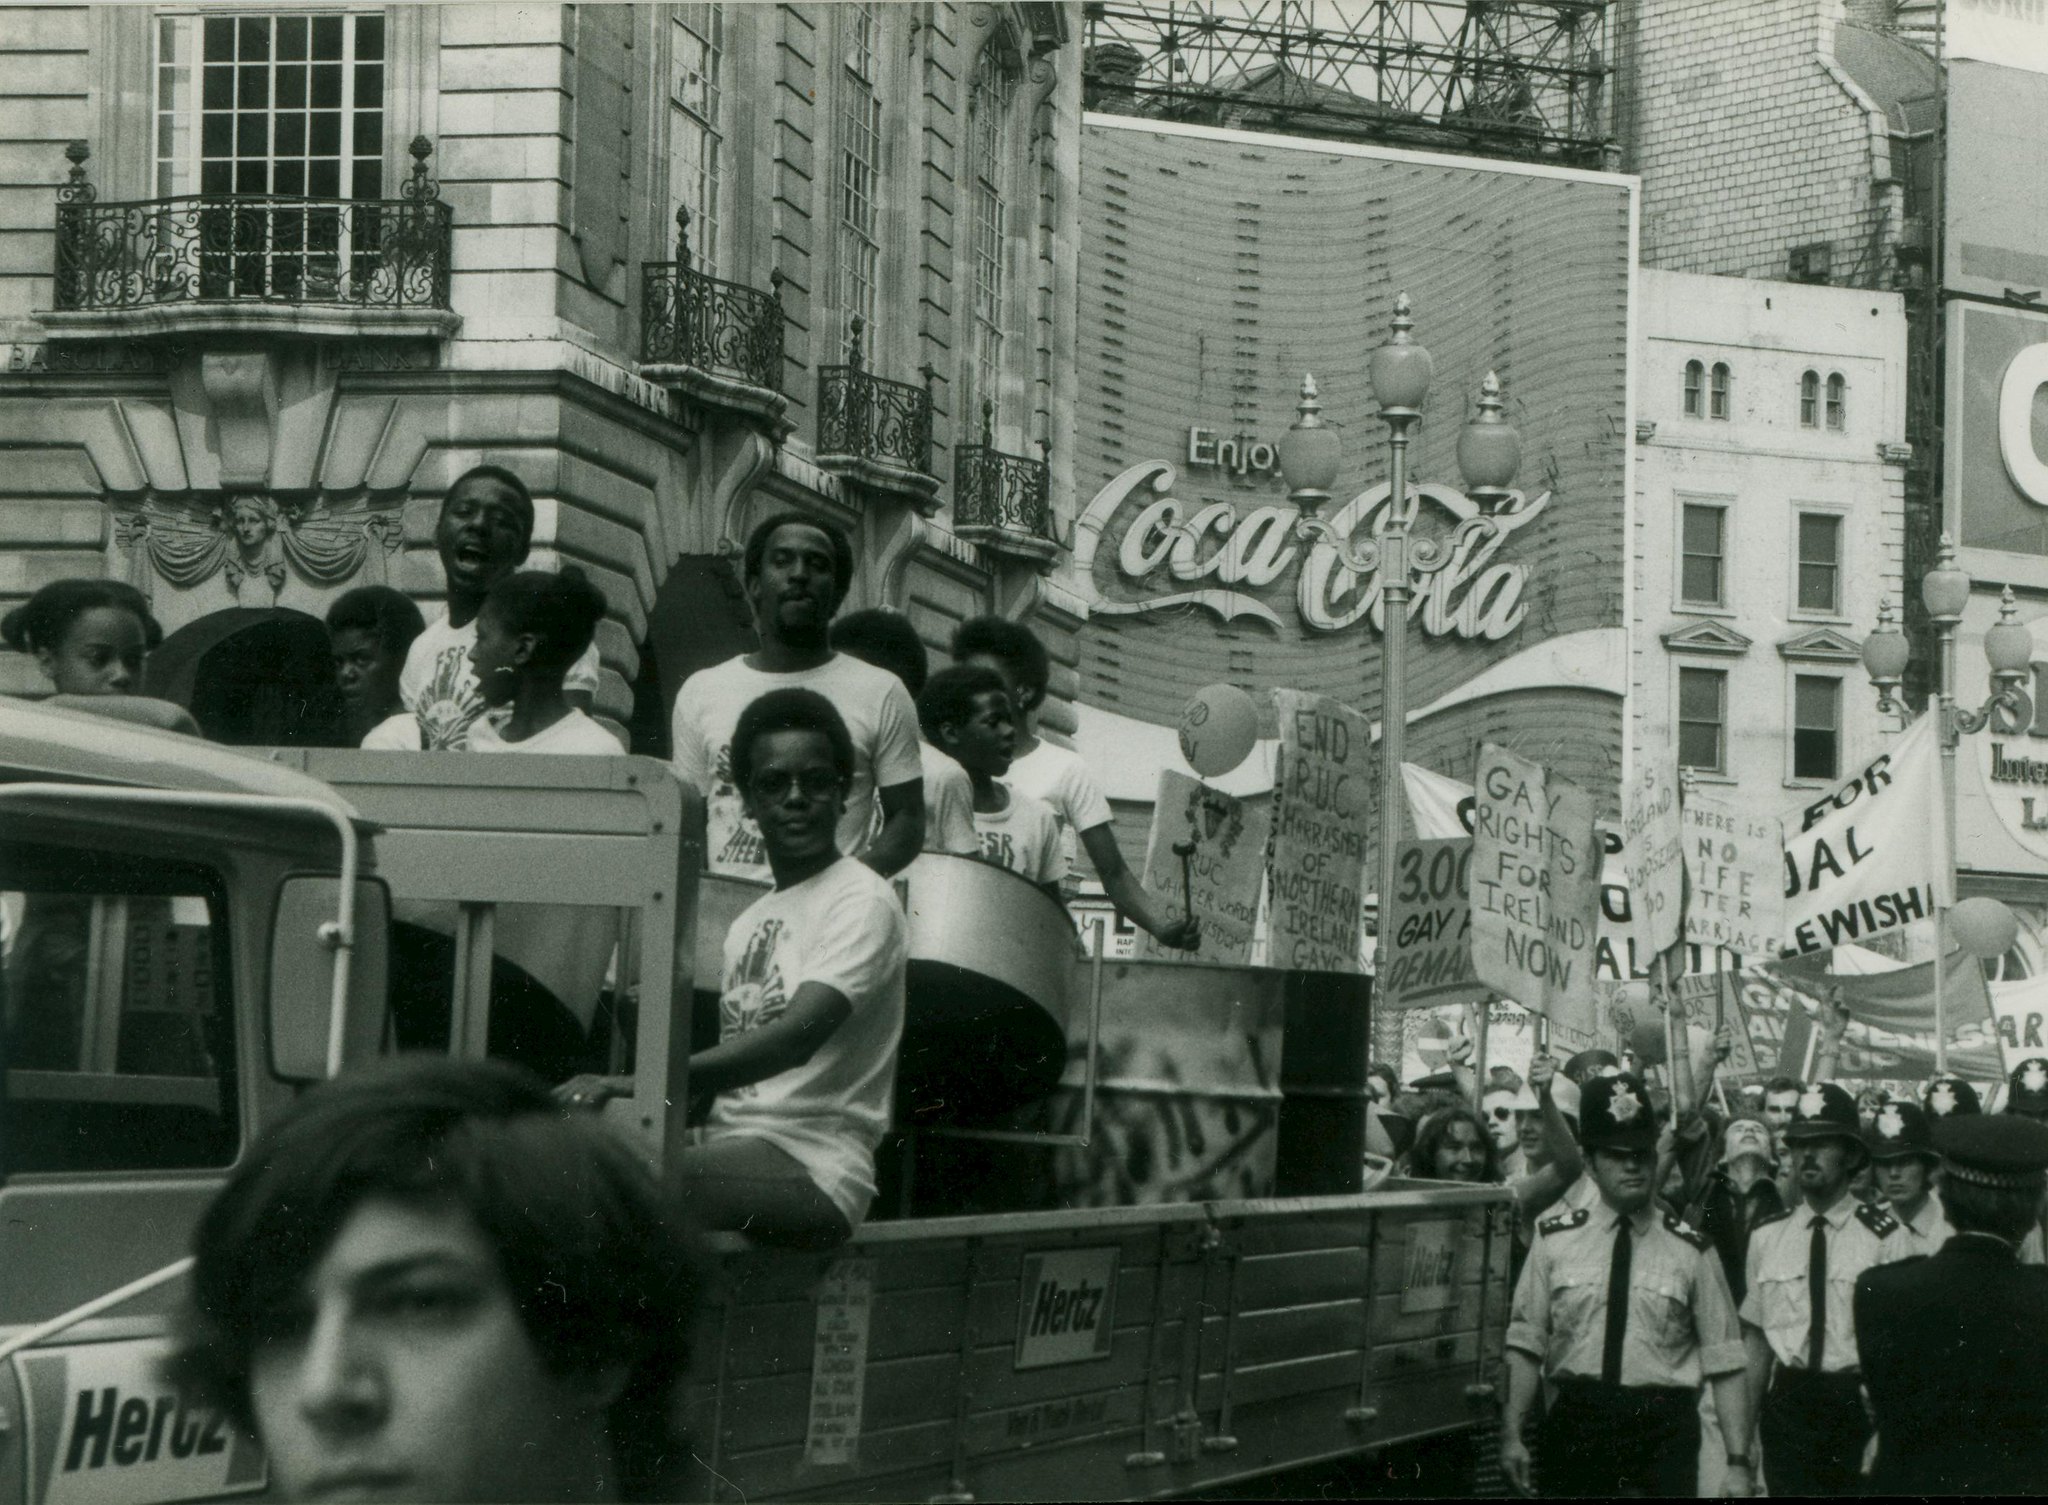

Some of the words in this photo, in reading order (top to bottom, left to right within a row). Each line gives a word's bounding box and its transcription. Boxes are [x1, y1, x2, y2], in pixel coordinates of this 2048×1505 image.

[325, 344, 413, 372] BANK
[1295, 709, 1350, 766] END
[1485, 765, 1561, 820] GAY
[1801, 753, 1893, 833] FOR
[1478, 803, 1576, 876] RIGHTS
[1684, 808, 1736, 834] THERE
[1747, 823, 1767, 839] IS
[1302, 853, 1332, 875] OF
[1698, 836, 1738, 864] NO
[1499, 851, 1552, 898] FOR
[1699, 861, 1755, 897] IFE
[1396, 907, 1456, 949] GAY
[1685, 917, 1777, 953] ARRIAGE
[1504, 927, 1573, 993] NOW
[1029, 1277, 1103, 1338] Hertz
